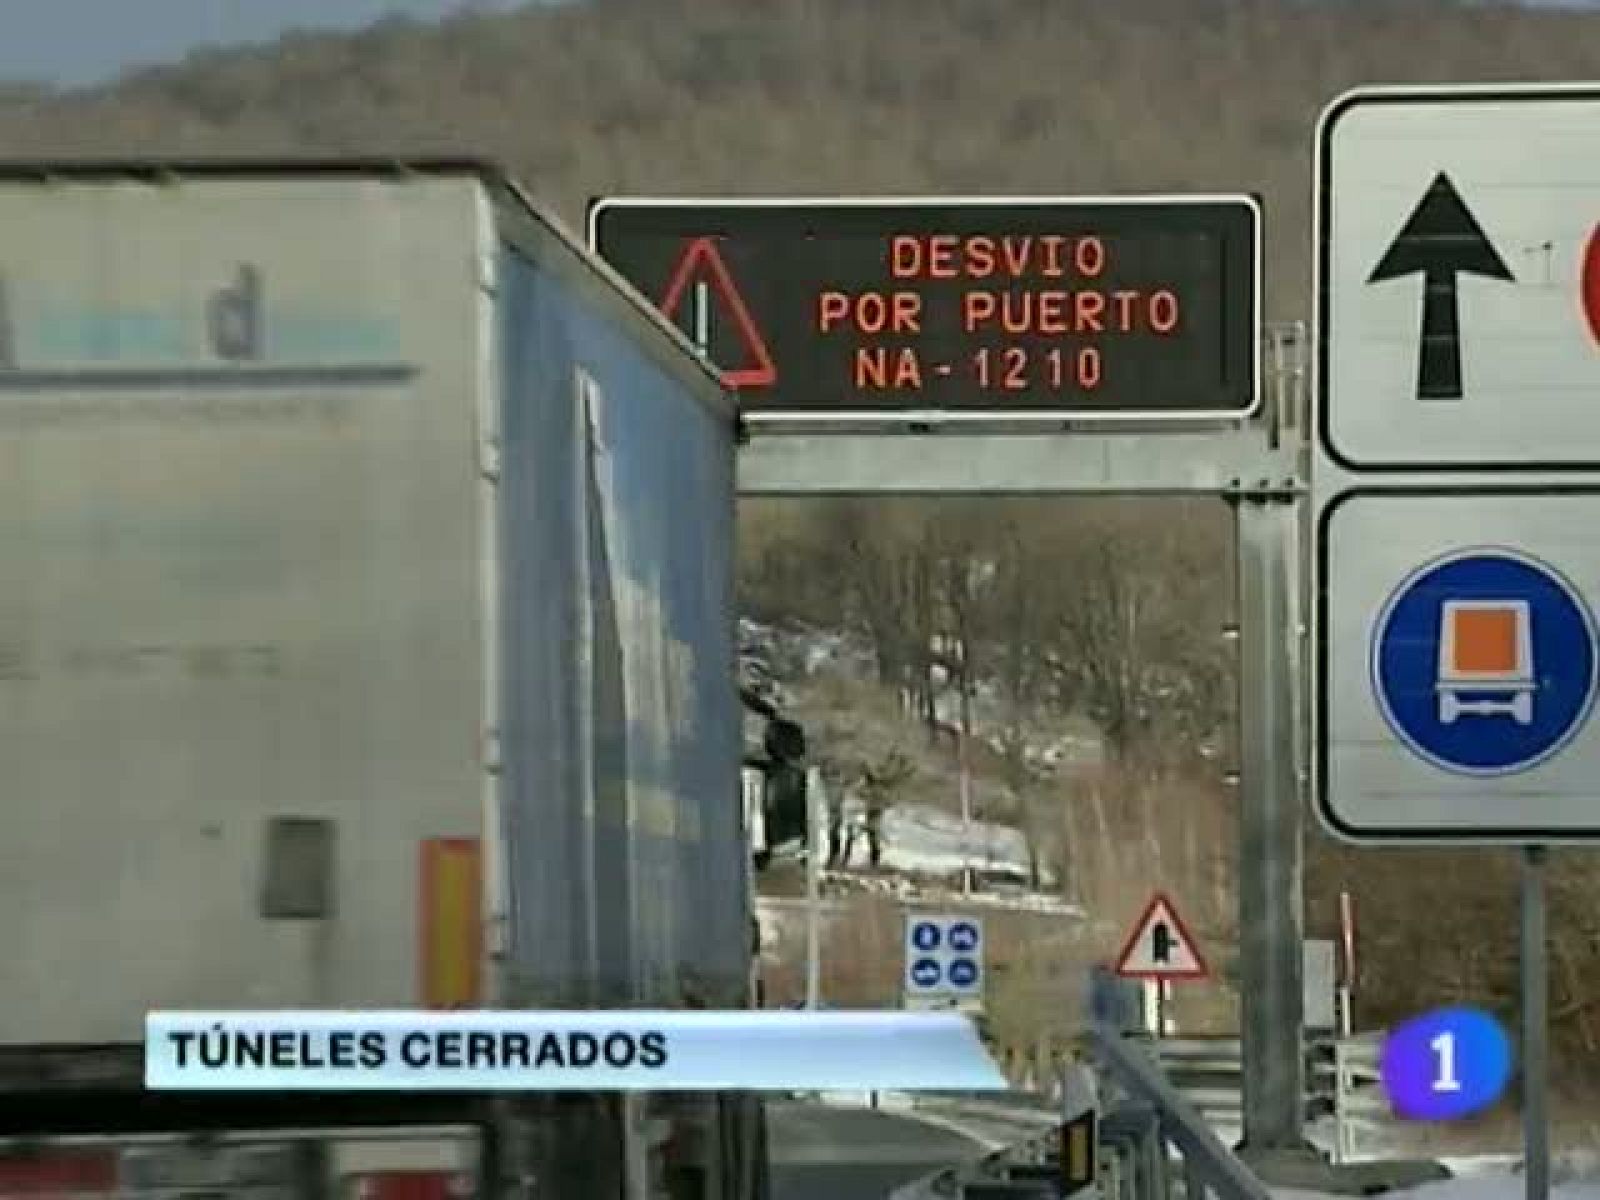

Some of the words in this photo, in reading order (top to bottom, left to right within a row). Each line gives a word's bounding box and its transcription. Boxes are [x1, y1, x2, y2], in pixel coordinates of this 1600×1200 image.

[892, 235, 1105, 278] DESVIO
[820, 291, 923, 333] POR
[965, 291, 1179, 333] PUERTO
[855, 347, 1101, 389] NA-1210
